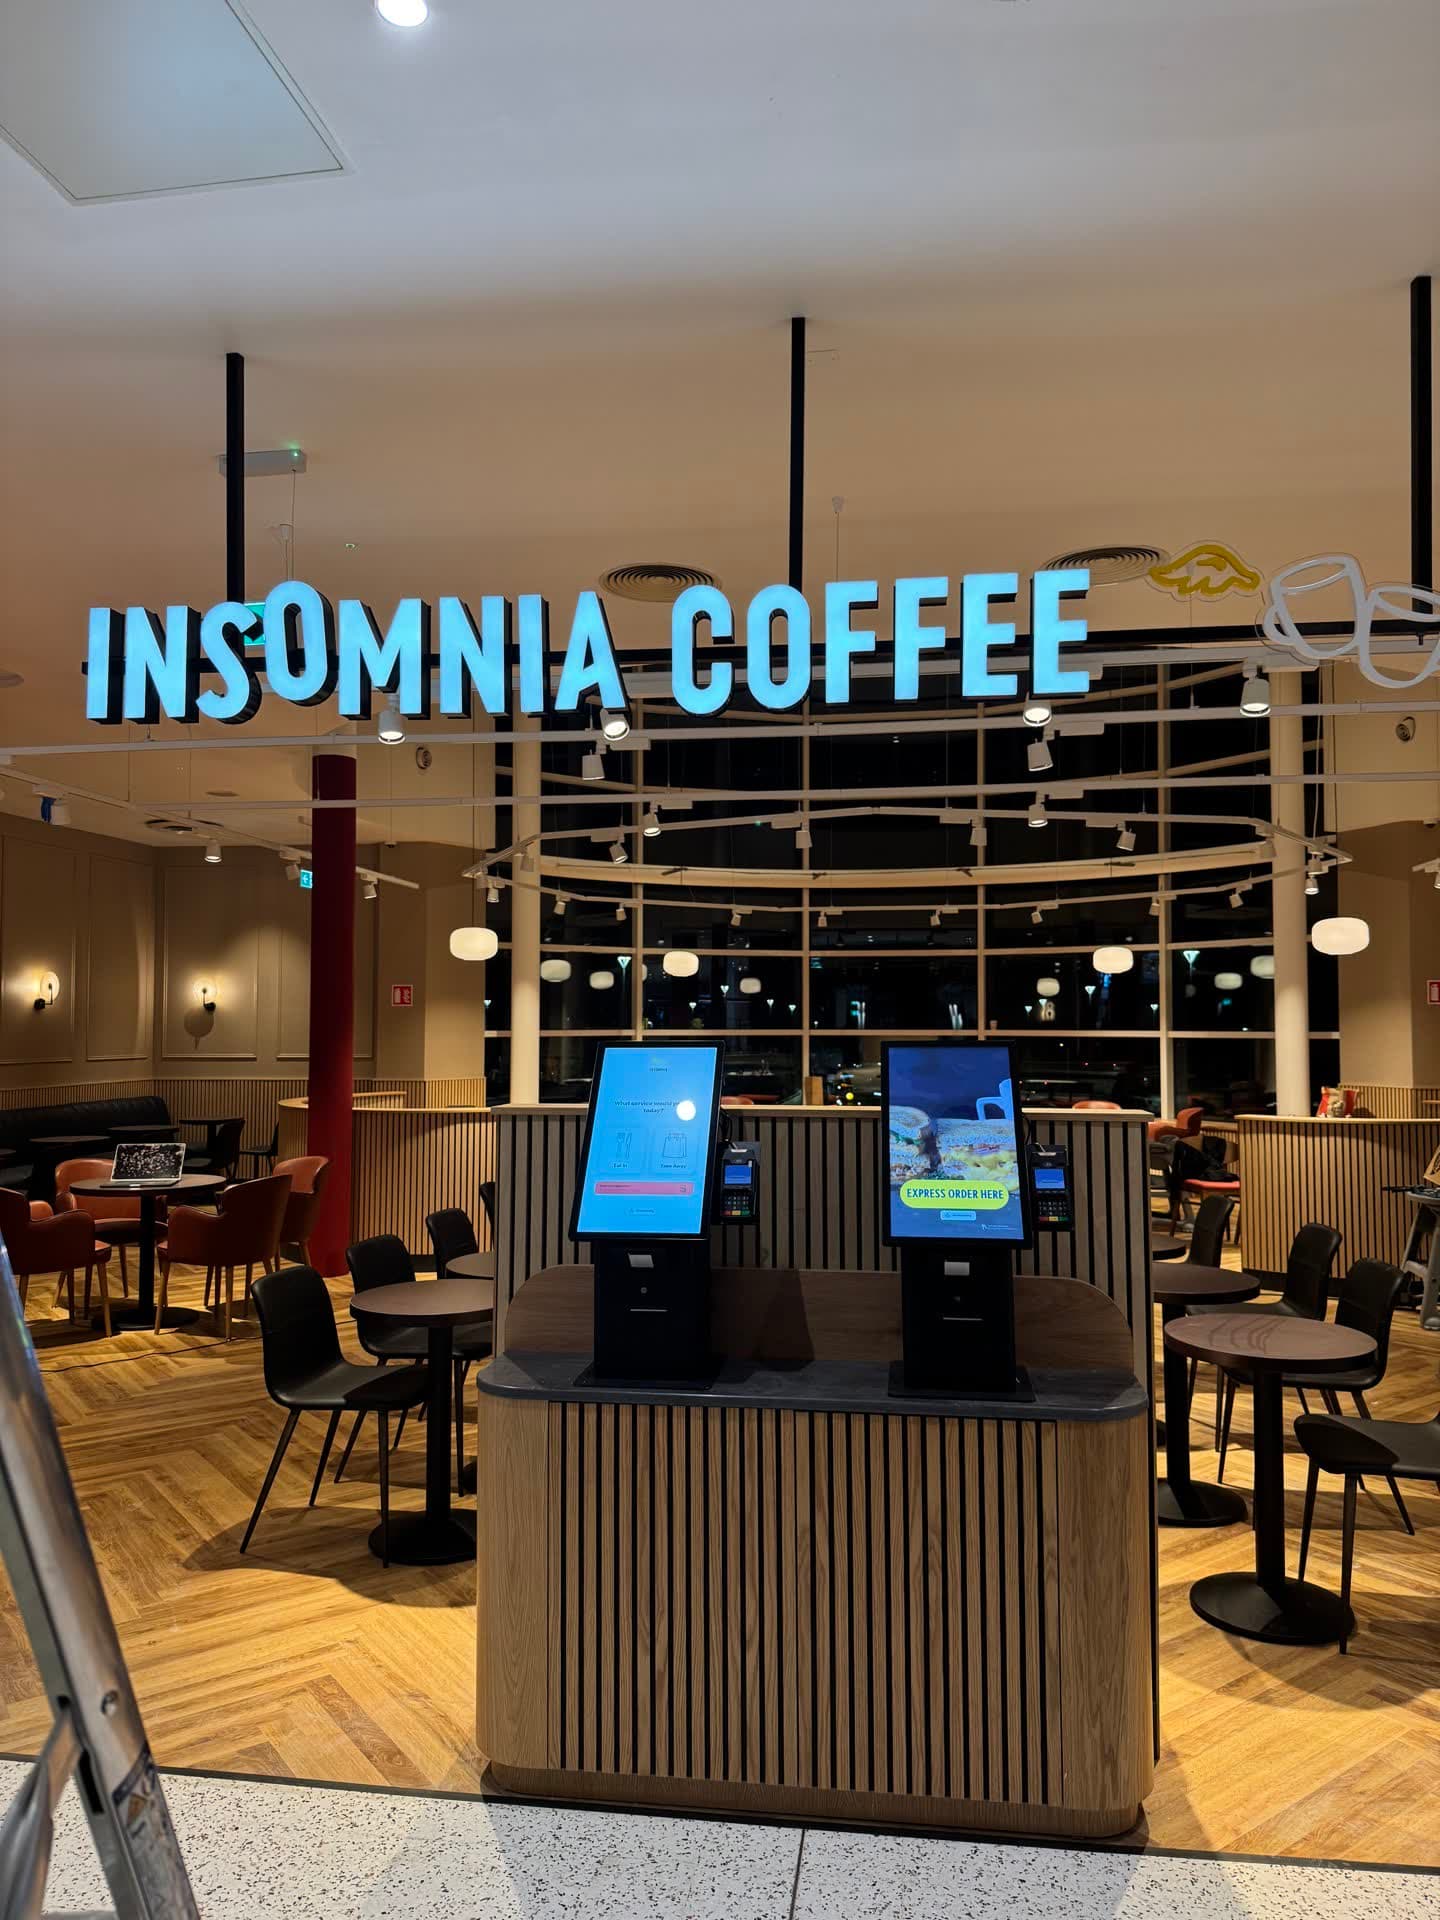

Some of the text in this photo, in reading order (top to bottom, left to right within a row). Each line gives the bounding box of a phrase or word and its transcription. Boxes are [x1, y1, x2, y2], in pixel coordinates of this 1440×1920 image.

[85, 568, 1090, 722] INSOMNIA COFFEE
[906, 1188, 1004, 1200] EXPRESS ORDER HERE
